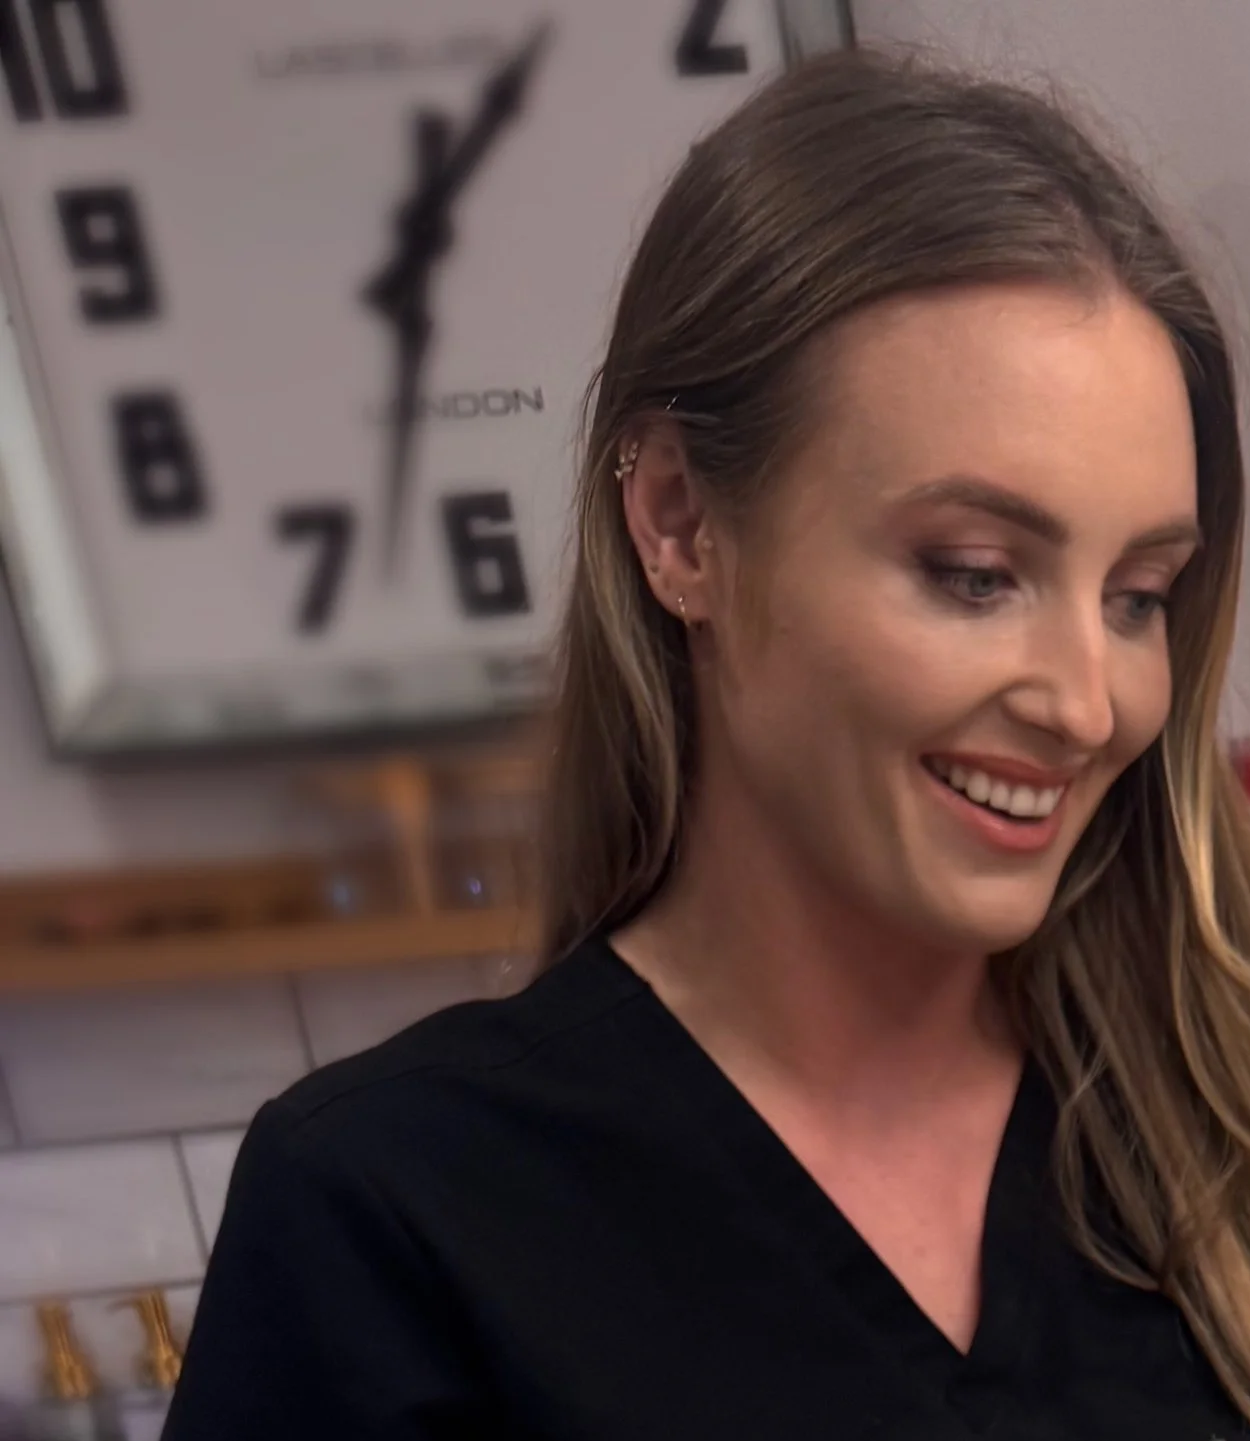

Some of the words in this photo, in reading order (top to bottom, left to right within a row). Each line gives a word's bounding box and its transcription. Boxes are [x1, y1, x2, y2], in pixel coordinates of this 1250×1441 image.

[0, 0, 131, 123] 10
[54, 186, 159, 323] 9
[112, 392, 209, 526] 8
[277, 507, 354, 636] 7
[442, 492, 532, 620] 6
